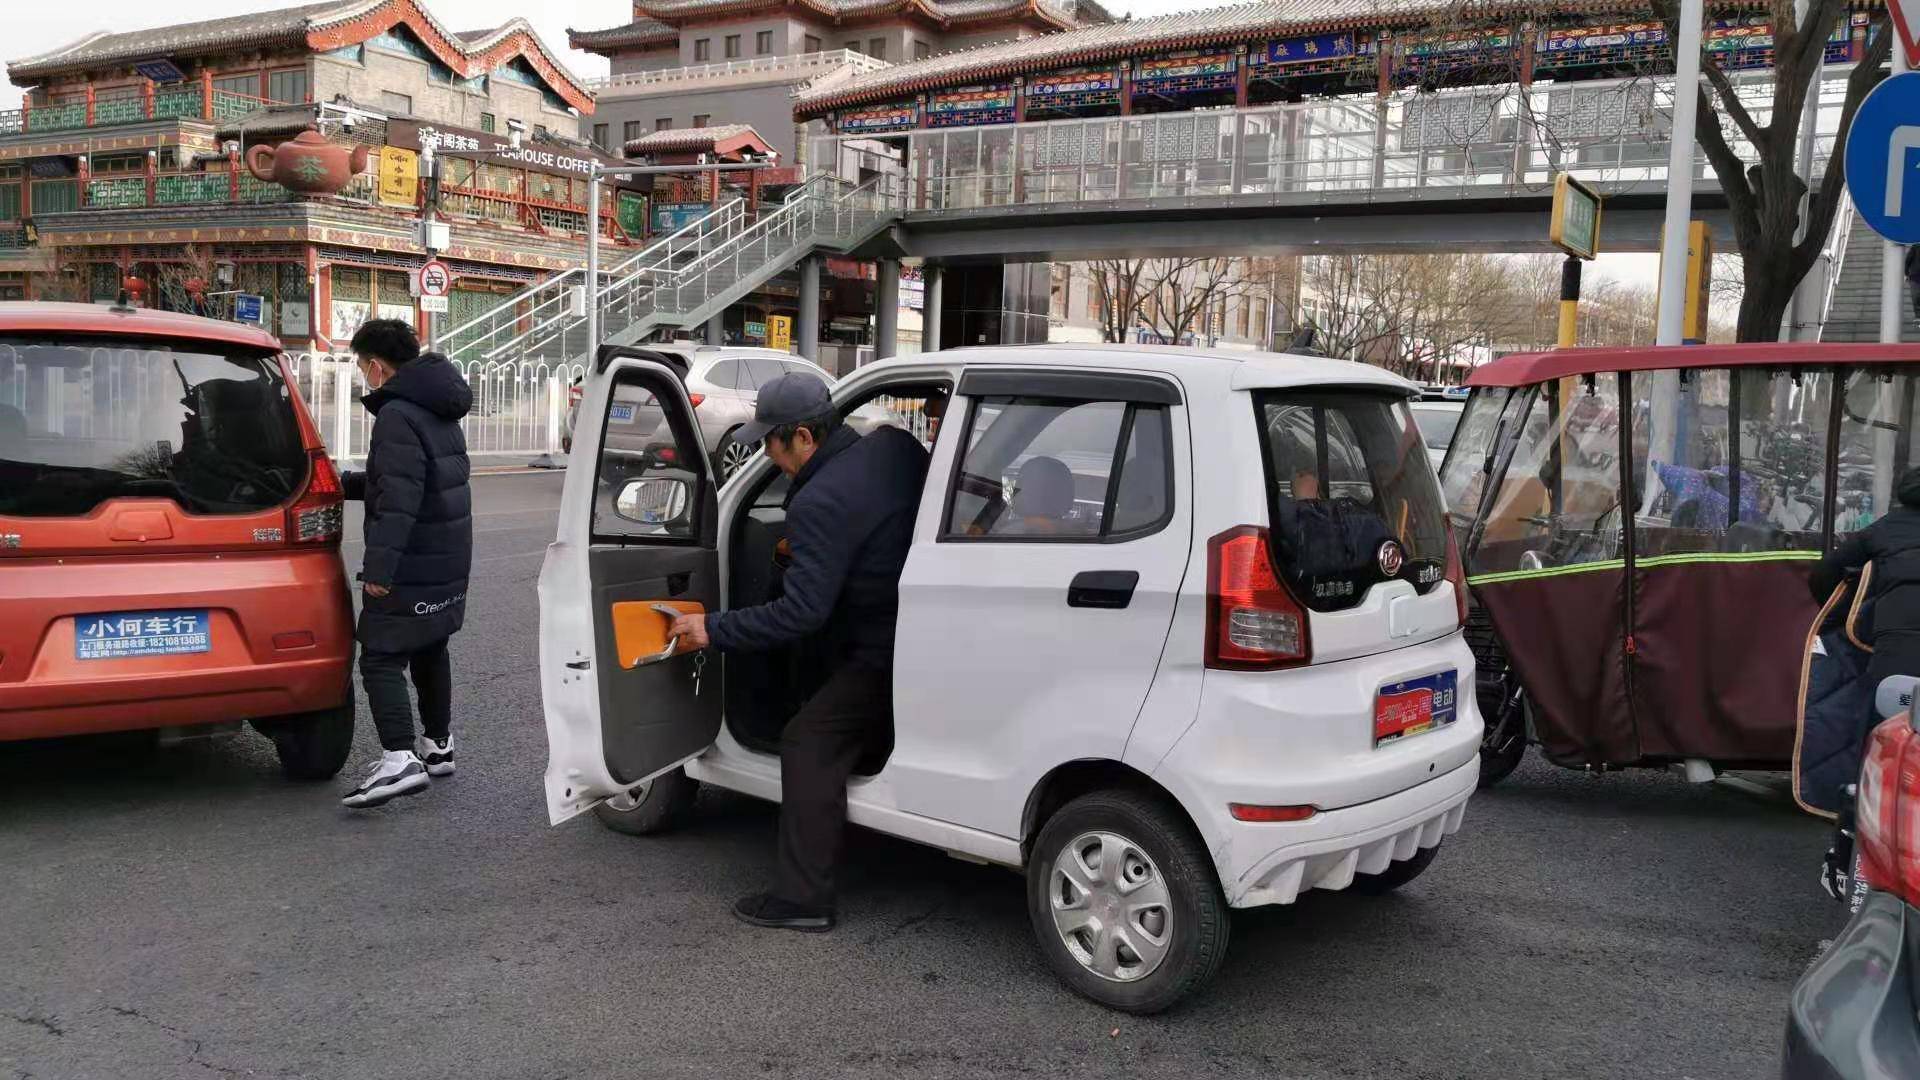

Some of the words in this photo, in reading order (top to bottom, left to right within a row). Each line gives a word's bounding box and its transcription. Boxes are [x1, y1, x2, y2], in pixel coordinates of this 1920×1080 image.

[292, 155, 328, 182] 茶
[556, 155, 595, 174] COFFE
[777, 320, 785, 336] P
[86, 616, 197, 637] 小何车行
[1433, 688, 1453, 707] 电动
